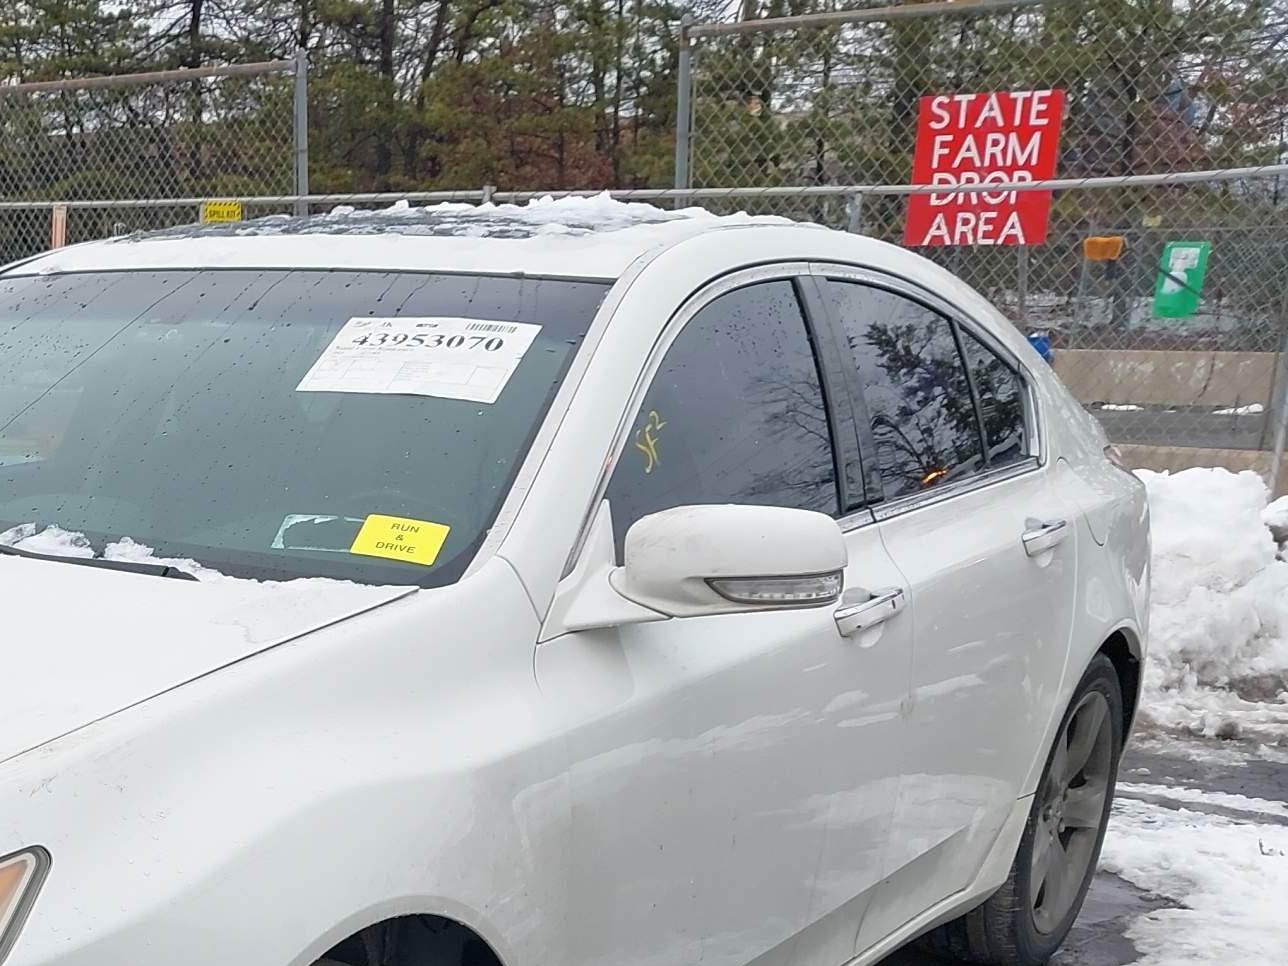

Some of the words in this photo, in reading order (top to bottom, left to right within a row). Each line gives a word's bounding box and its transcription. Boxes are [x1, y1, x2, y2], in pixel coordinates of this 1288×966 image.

[929, 90, 1053, 129] STATE
[931, 131, 1042, 169] FARM
[930, 170, 1033, 206] DROP
[922, 211, 1025, 246] AREA
[351, 332, 505, 352] 43953070
[391, 523, 420, 533] RUN
[376, 541, 416, 554] DRIVE
